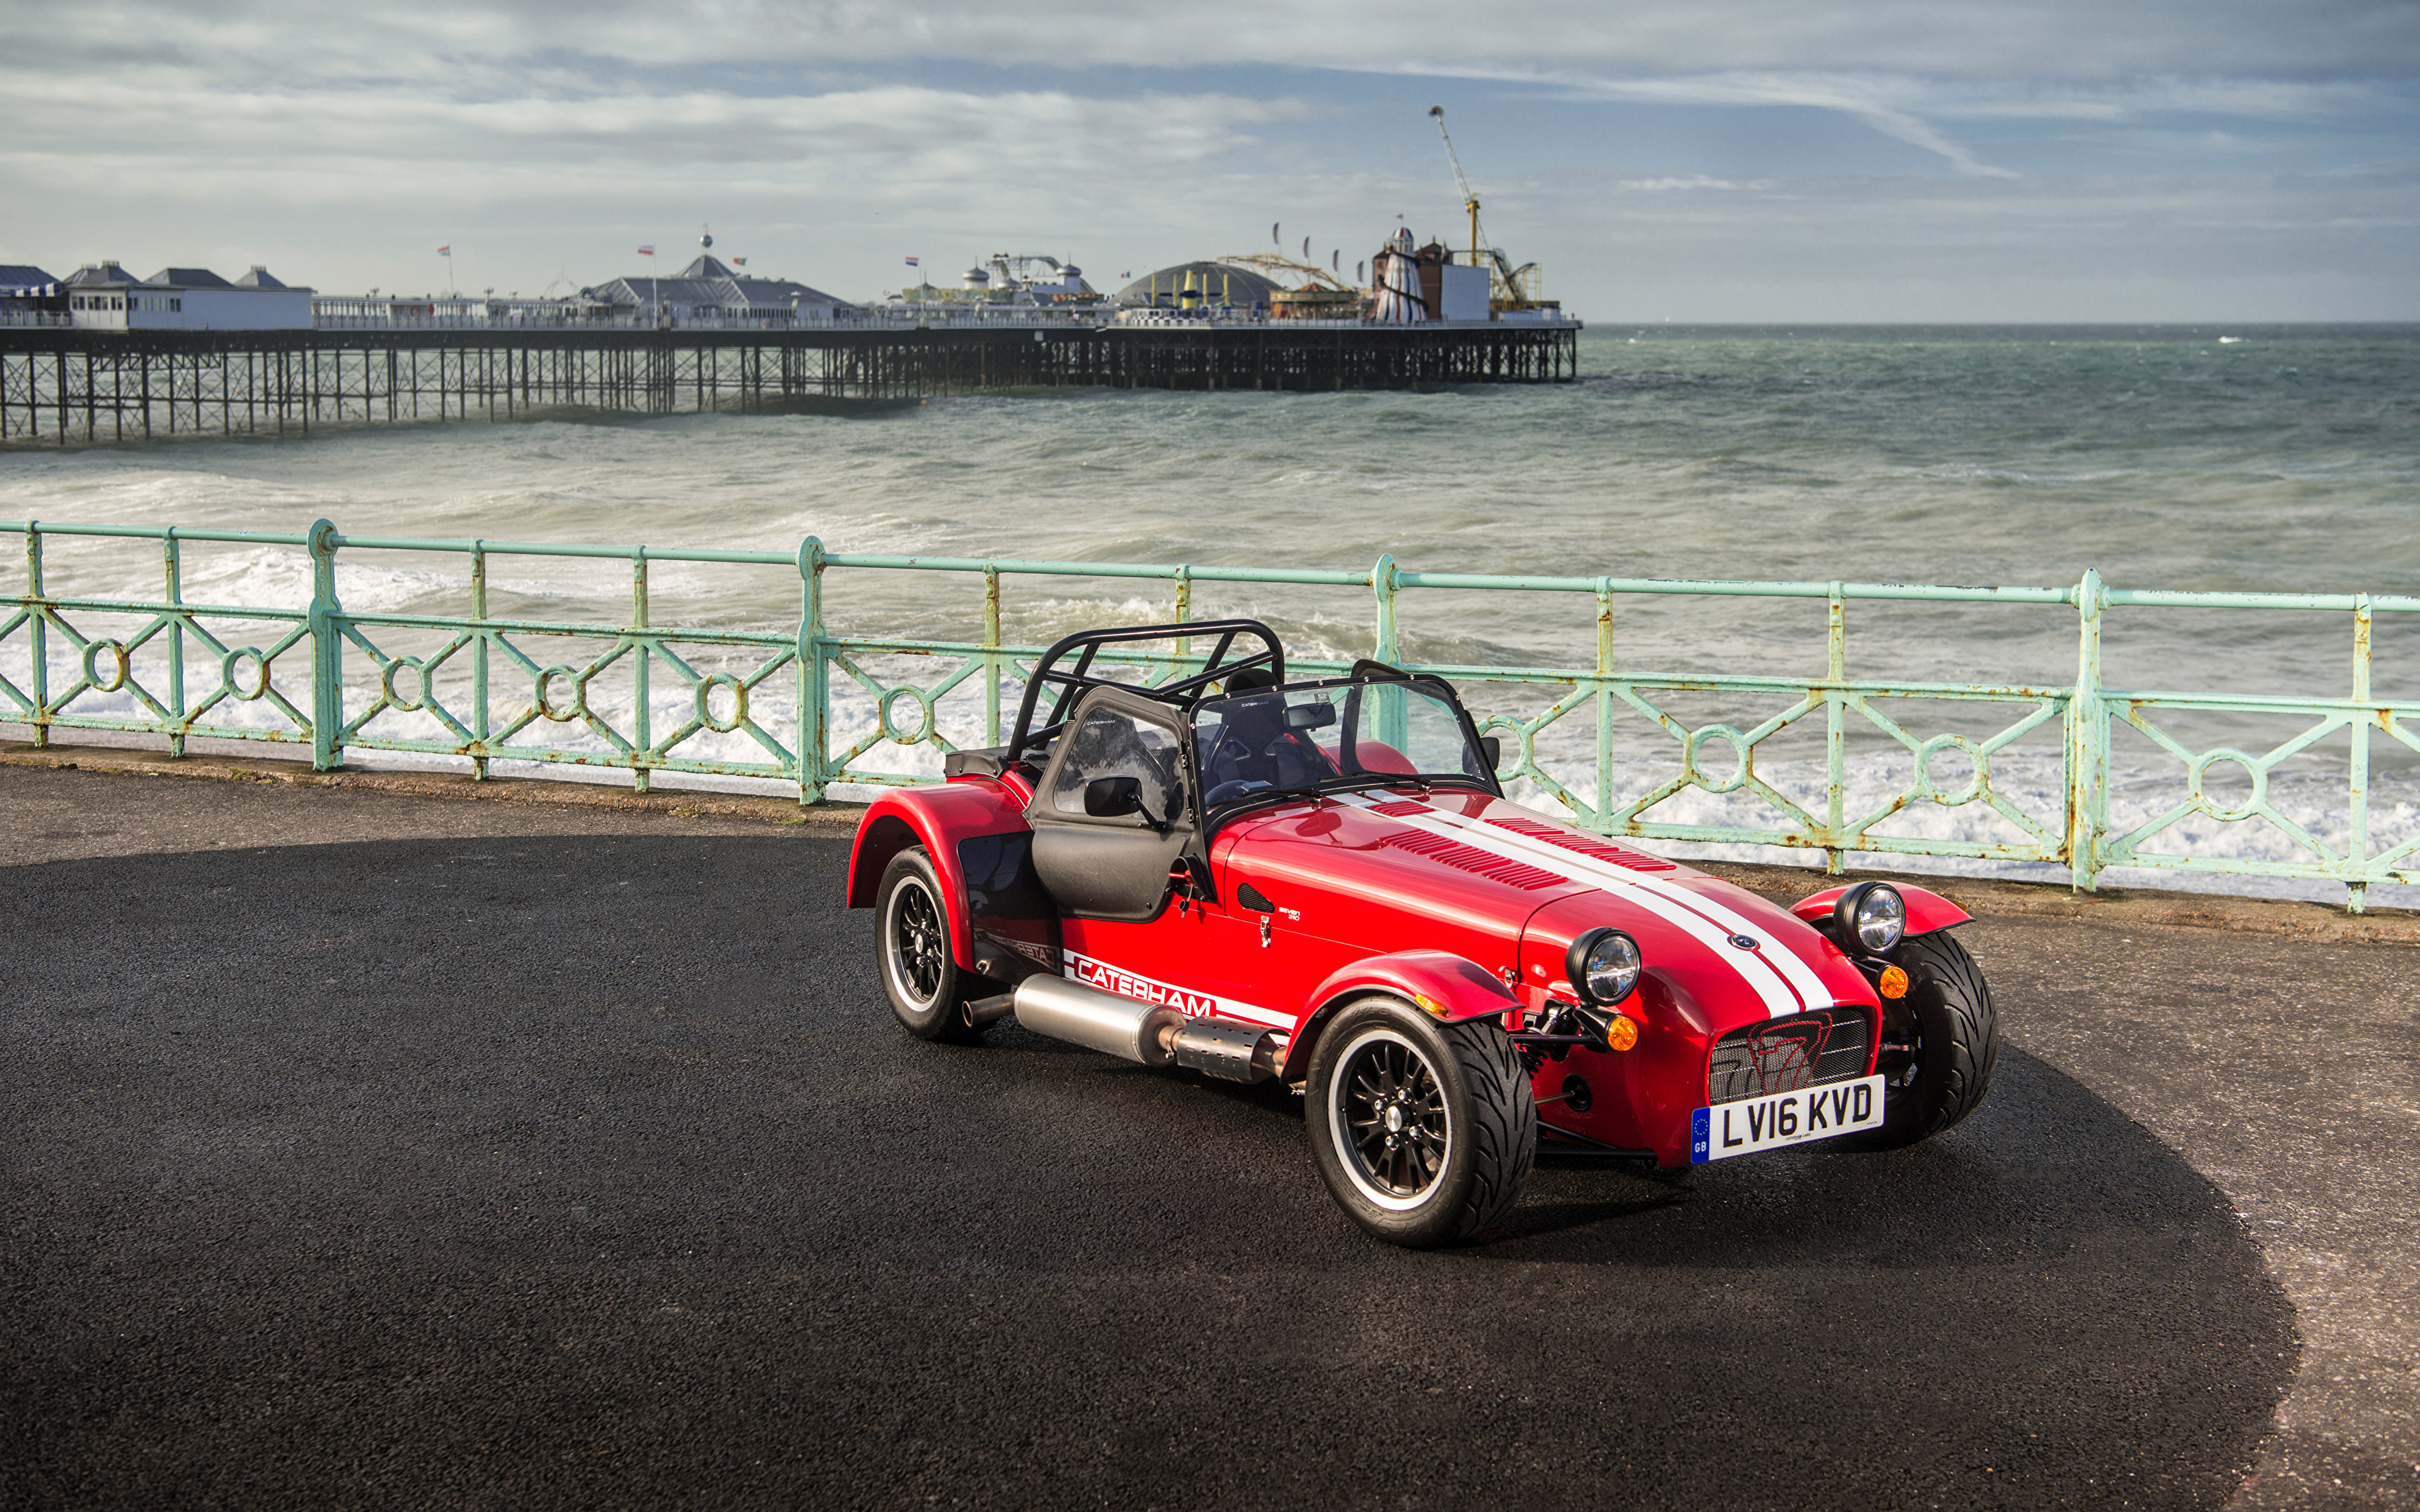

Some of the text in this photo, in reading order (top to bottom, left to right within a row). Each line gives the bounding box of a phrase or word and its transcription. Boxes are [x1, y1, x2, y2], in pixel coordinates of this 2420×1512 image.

[1279, 907, 1300, 916] SEVEN
[1078, 959, 1211, 1017] CATERHAM
[1723, 1083, 1872, 1148] LV16 KVD
[1695, 1141, 1707, 1153] GB
